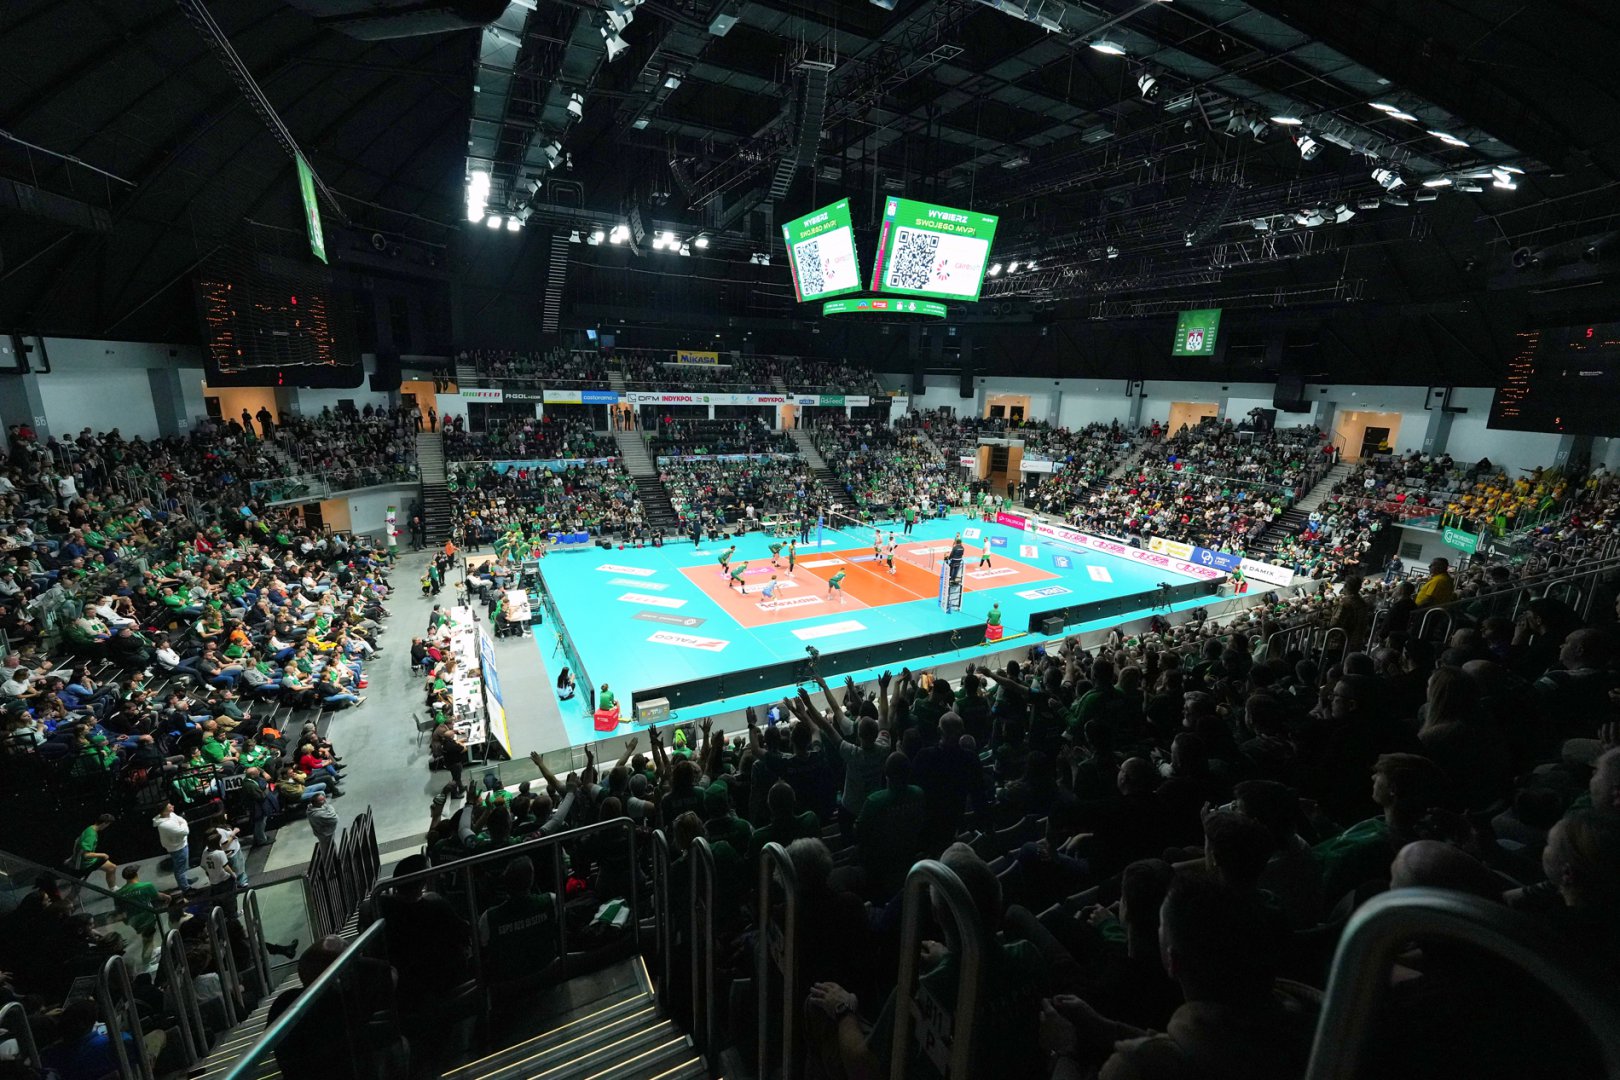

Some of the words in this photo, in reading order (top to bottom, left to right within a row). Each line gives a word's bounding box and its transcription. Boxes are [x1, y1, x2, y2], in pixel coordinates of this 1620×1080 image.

[803, 211, 829, 228] WYBIERZ
[928, 209, 968, 224] WYBIERZ
[799, 224, 823, 239] SWOJEGO
[915, 218, 955, 231] SWOJEGO
[956, 225, 976, 236] MVP!
[1249, 566, 1274, 576] DAMIX
[655, 634, 698, 644] FALCO
[225, 777, 243, 789] A10
